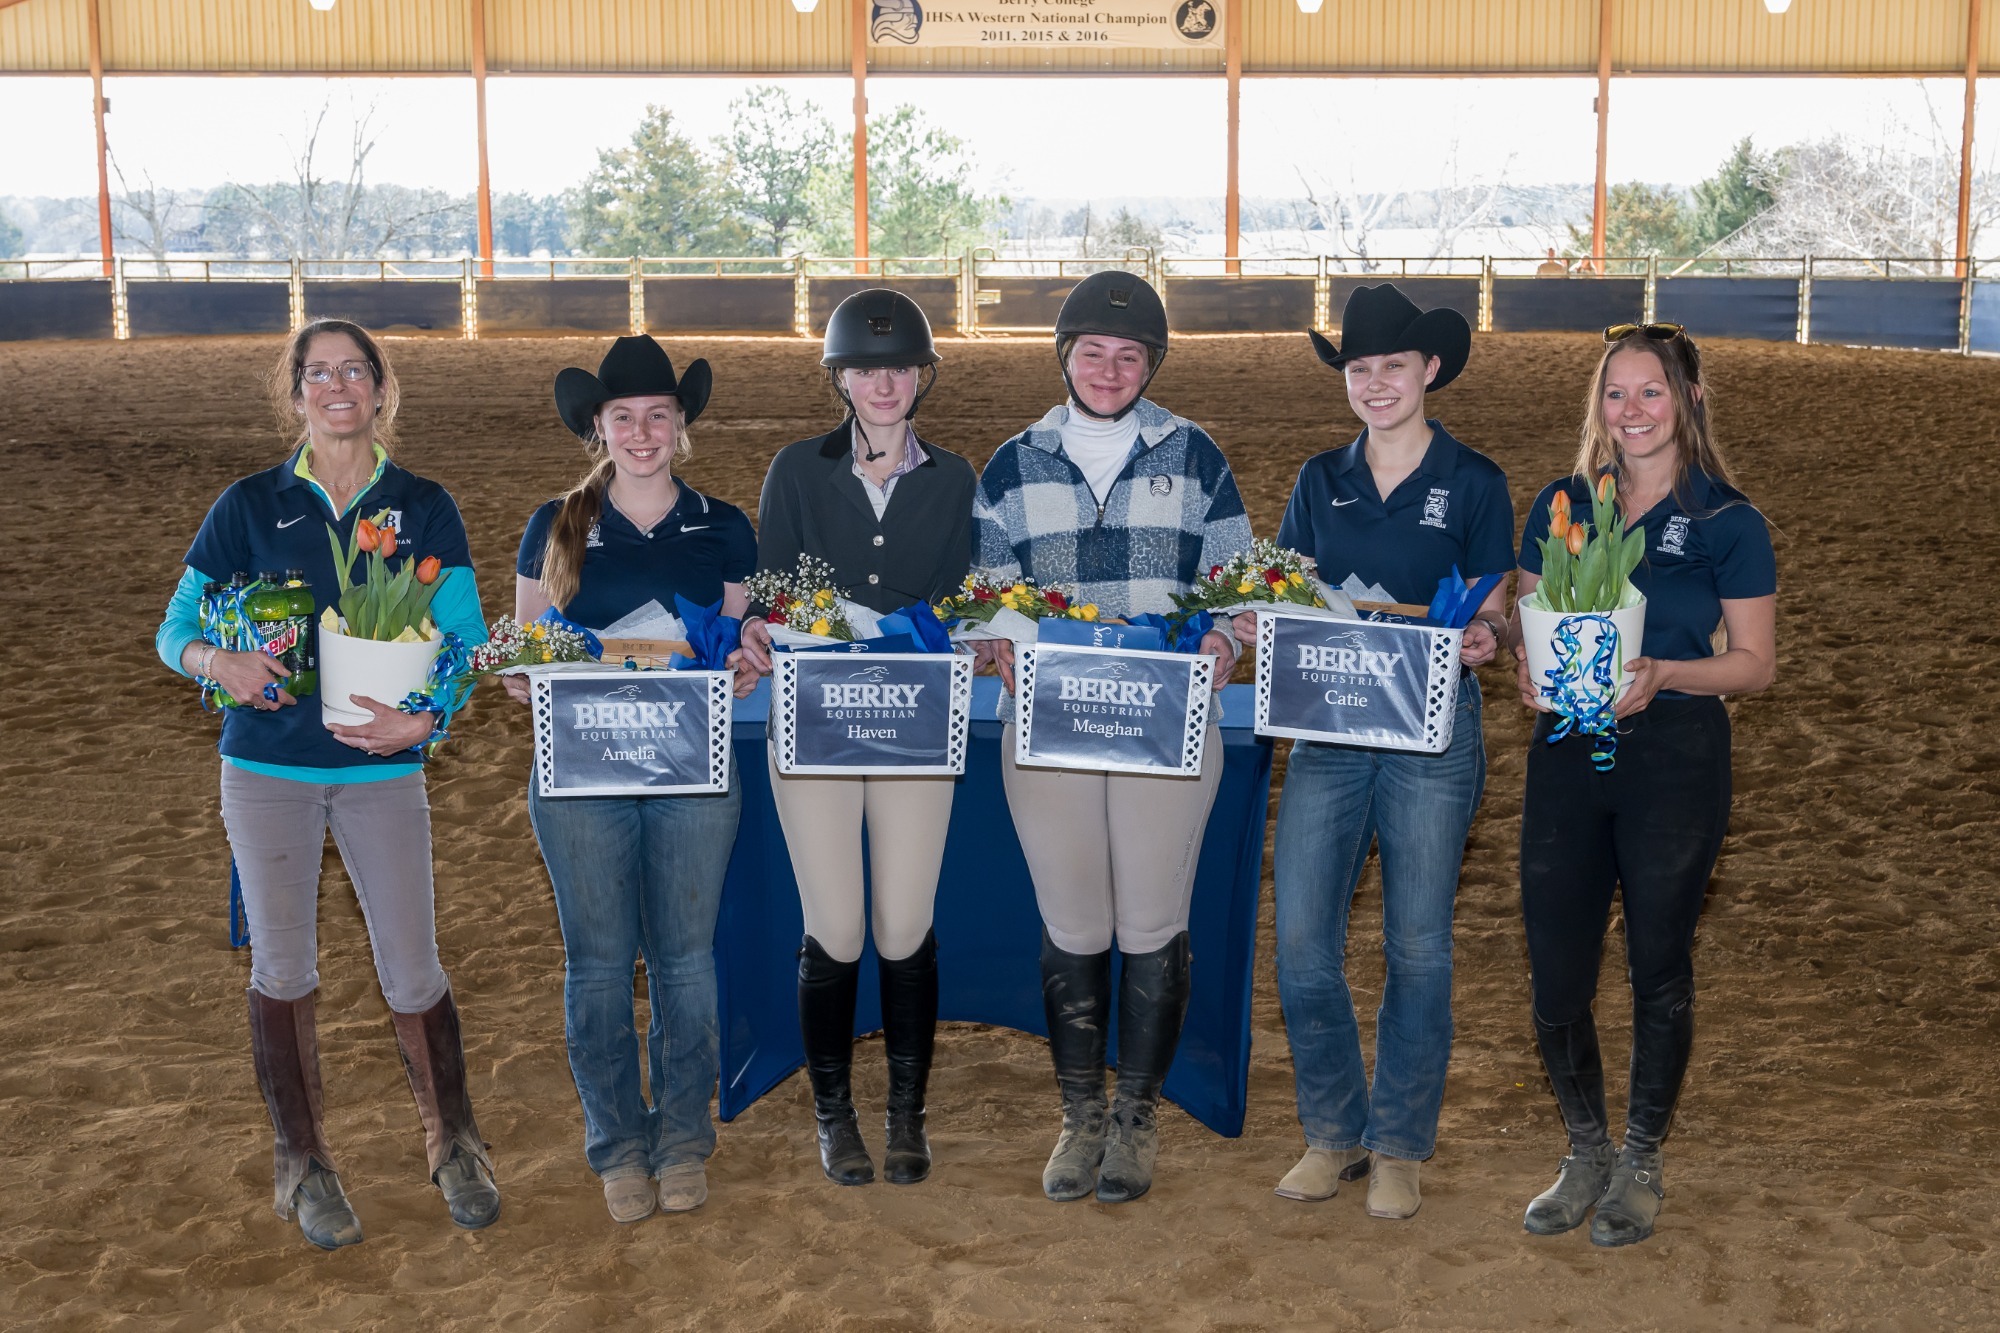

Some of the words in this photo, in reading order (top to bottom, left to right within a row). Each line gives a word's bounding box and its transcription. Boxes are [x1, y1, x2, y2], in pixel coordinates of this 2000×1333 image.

[925, 12, 965, 23] IHSA
[969, 12, 1025, 23] Western
[1030, 12, 1090, 24] National
[1094, 12, 1167, 27] Champion
[980, 30, 1016, 43] 2011,
[1021, 30, 1054, 42] 2015
[1058, 30, 1070, 42] &
[1076, 30, 1108, 42] 2016
[1430, 488, 1450, 496] BERRY
[1670, 515, 1691, 524] BERRY
[1296, 644, 1404, 678] BERRY
[1301, 671, 1393, 688] EQUESTRIAN
[820, 683, 925, 708] BERRY
[1058, 676, 1163, 708] BERRY
[1324, 690, 1368, 708] Catie
[572, 701, 686, 729] BERRY
[826, 709, 916, 720] EQUESTRIAN
[1063, 703, 1152, 718] EQUESTRIAN
[581, 729, 677, 742] EQUESTRIAN
[847, 724, 897, 739] Haven
[1072, 718, 1144, 738] Meaghan
[601, 746, 656, 761] Amelia
